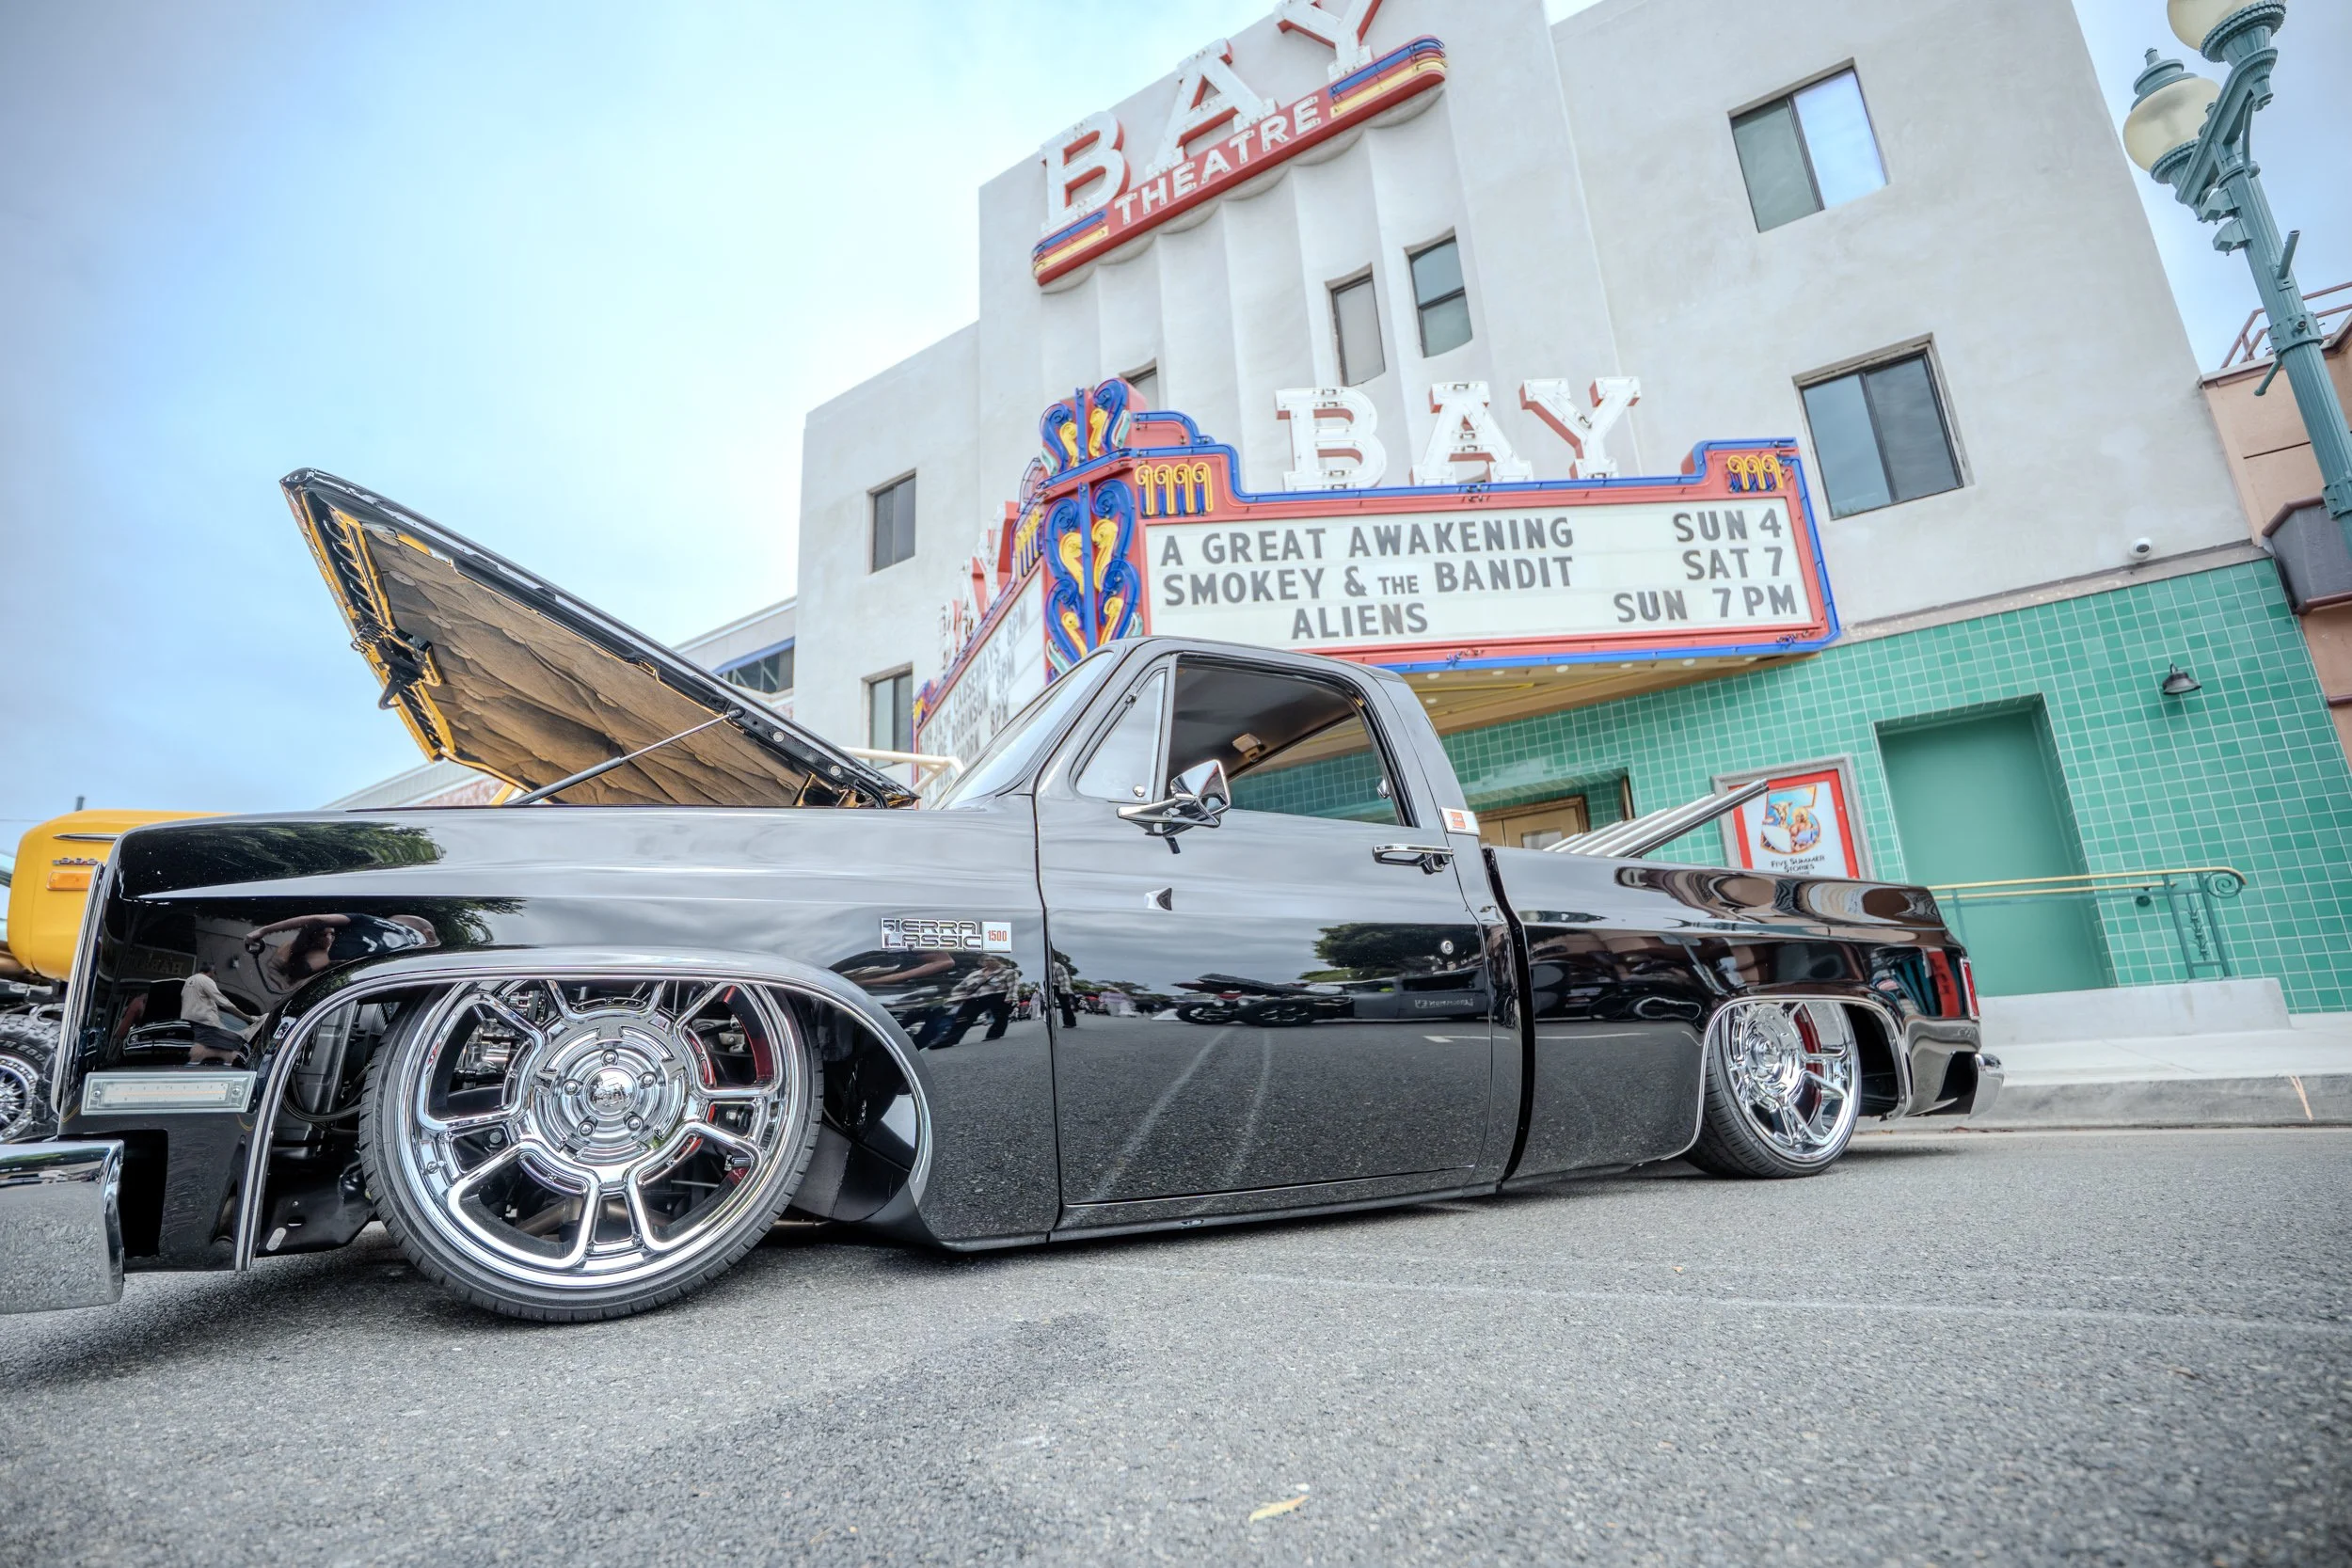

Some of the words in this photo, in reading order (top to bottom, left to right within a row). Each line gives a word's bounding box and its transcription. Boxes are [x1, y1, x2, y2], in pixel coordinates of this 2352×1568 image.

[1040, 0, 1383, 237] BAY
[1114, 96, 1322, 227] THEATRE
[1275, 377, 1641, 491] BAY
[1160, 535, 1184, 566] A
[1202, 528, 1327, 564] GREAT
[1348, 516, 1574, 558] AWAKENING
[1673, 510, 1748, 543] SUN
[1759, 507, 1782, 538] 4
[1164, 566, 1325, 607] SMOKEY
[1343, 566, 1368, 597] &
[1377, 575, 1420, 595] THE
[1435, 556, 1574, 594] BANDIT
[1682, 546, 1749, 580] SAT
[1763, 546, 1783, 577] 7
[1007, 599, 1028, 647] 8PM
[1291, 602, 1429, 640] ALIENS
[1613, 590, 1689, 623] SUN
[995, 649, 1016, 695] 8PM
[989, 693, 1009, 736] 8PM
[1771, 860, 1788, 868] FIVE
[1789, 855, 1825, 864] SUMMER
[1784, 863, 1815, 873] STORIES
[882, 918, 977, 935] SIERRA
[882, 932, 981, 948] LASSIC
[987, 930, 1008, 942] 1500
